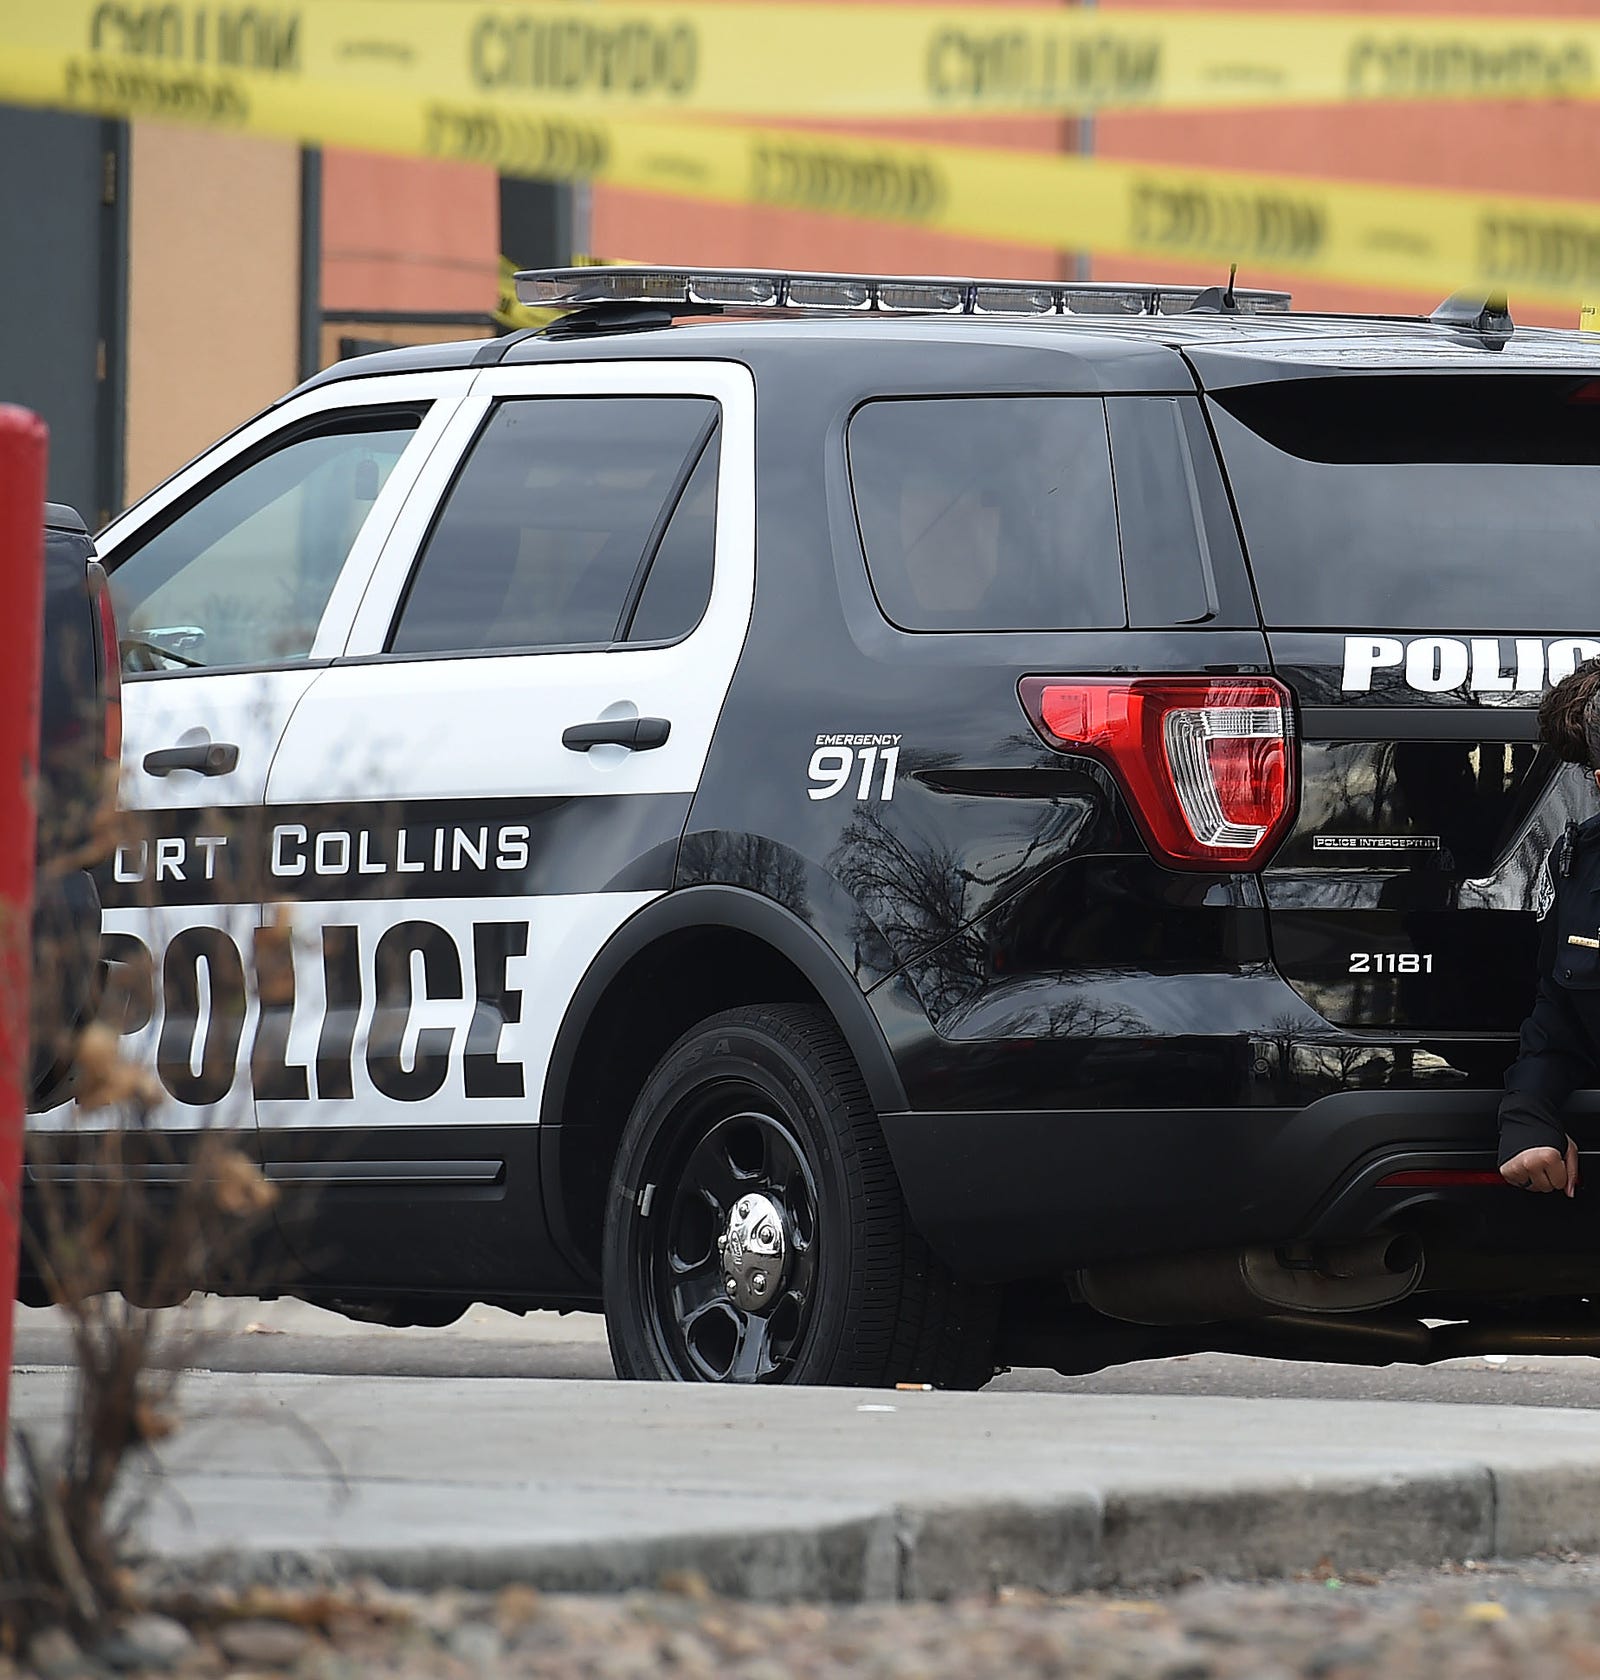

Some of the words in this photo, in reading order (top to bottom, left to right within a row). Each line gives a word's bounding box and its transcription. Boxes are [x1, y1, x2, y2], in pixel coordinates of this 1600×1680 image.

[815, 734, 902, 746] EMERGENCY
[807, 746, 901, 801] 911
[1316, 838, 1357, 847] POLICE
[113, 836, 228, 884] ORT
[1348, 952, 1433, 973] 21181
